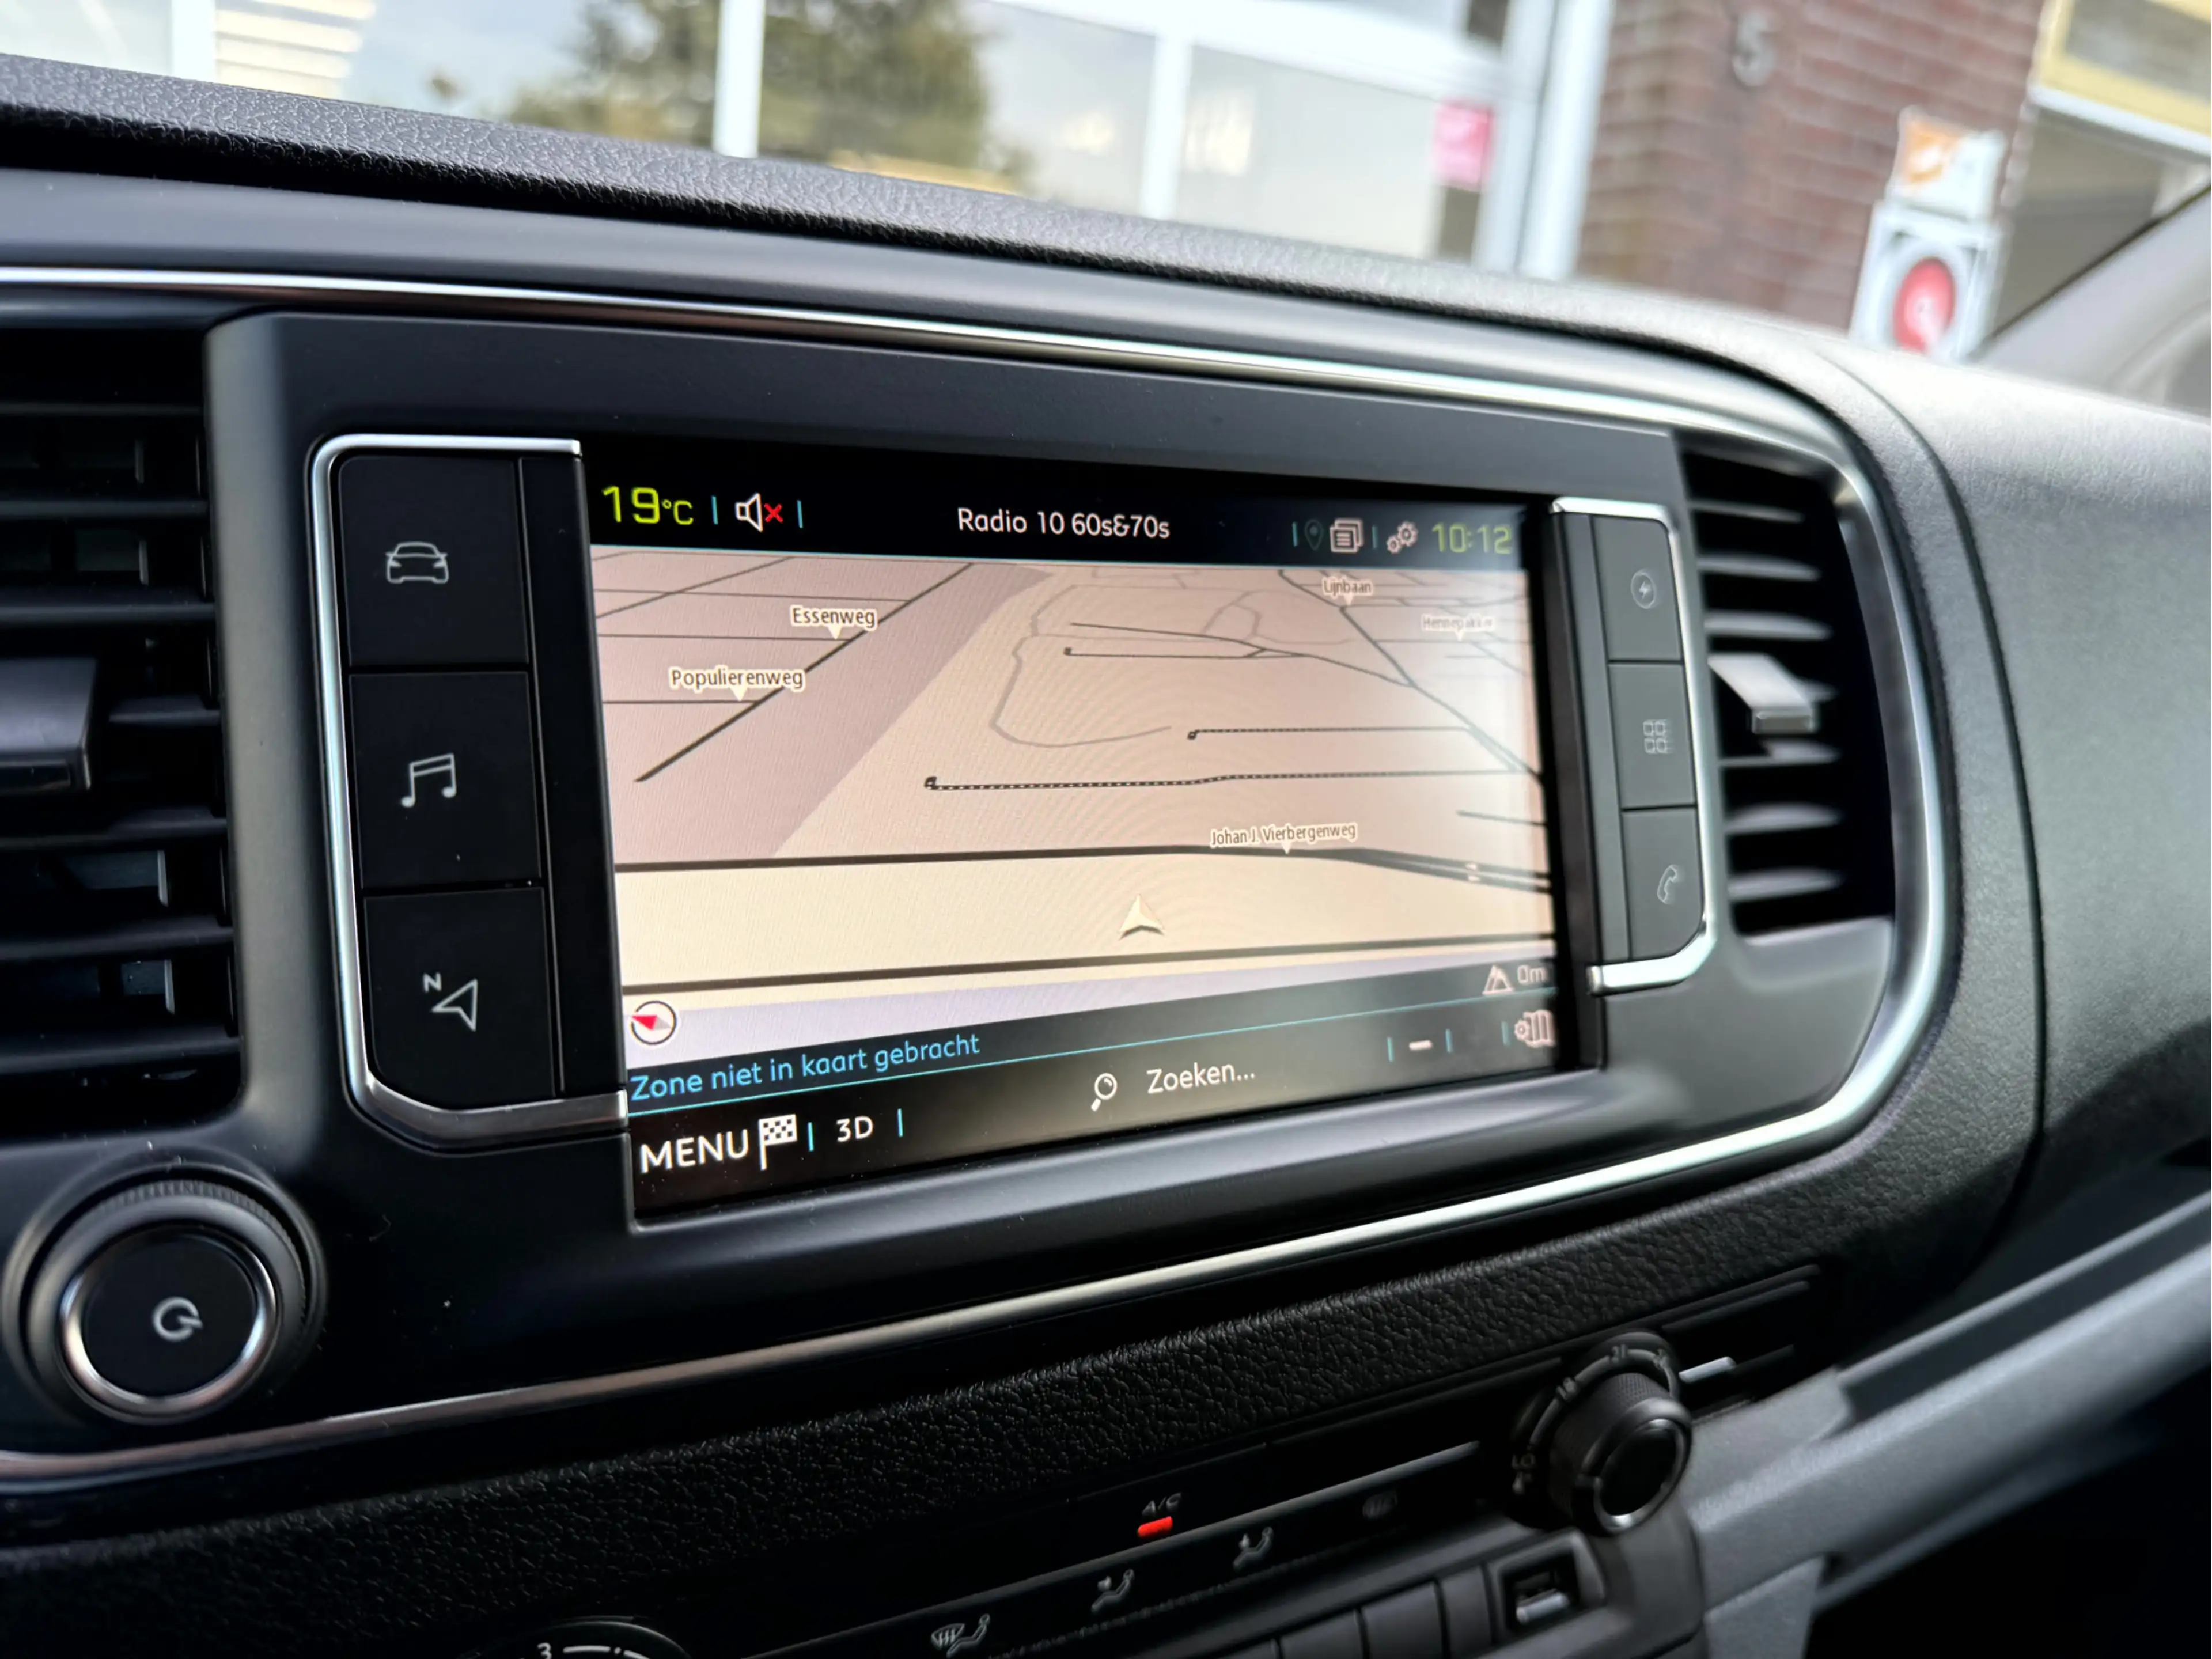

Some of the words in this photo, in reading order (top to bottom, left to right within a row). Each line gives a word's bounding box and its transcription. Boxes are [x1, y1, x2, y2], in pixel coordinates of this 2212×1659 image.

[957, 507, 1028, 533] Radio
[1037, 511, 1065, 535] 10
[1071, 512, 1170, 539] 60s&70s
[1432, 522, 1512, 554] 10:12
[1324, 578, 1371, 596] Lijnbaan
[793, 608, 875, 628] Essenweg
[672, 669, 803, 690] Populierenweg
[1212, 829, 1247, 846] Johan
[1262, 824, 1356, 842] Vierbergenweg
[423, 972, 442, 993] N
[1517, 965, 1546, 983] 0m
[630, 1075, 703, 1101] Zone
[711, 1064, 762, 1090] niet
[771, 1059, 793, 1081] in
[802, 1049, 867, 1076] kaart
[875, 1035, 979, 1071] gebracht
[1146, 1062, 1256, 1093] Zoeken...
[836, 1116, 874, 1142] 3D
[640, 1129, 749, 1174] MENU
[1142, 1493, 1181, 1515] A/C
